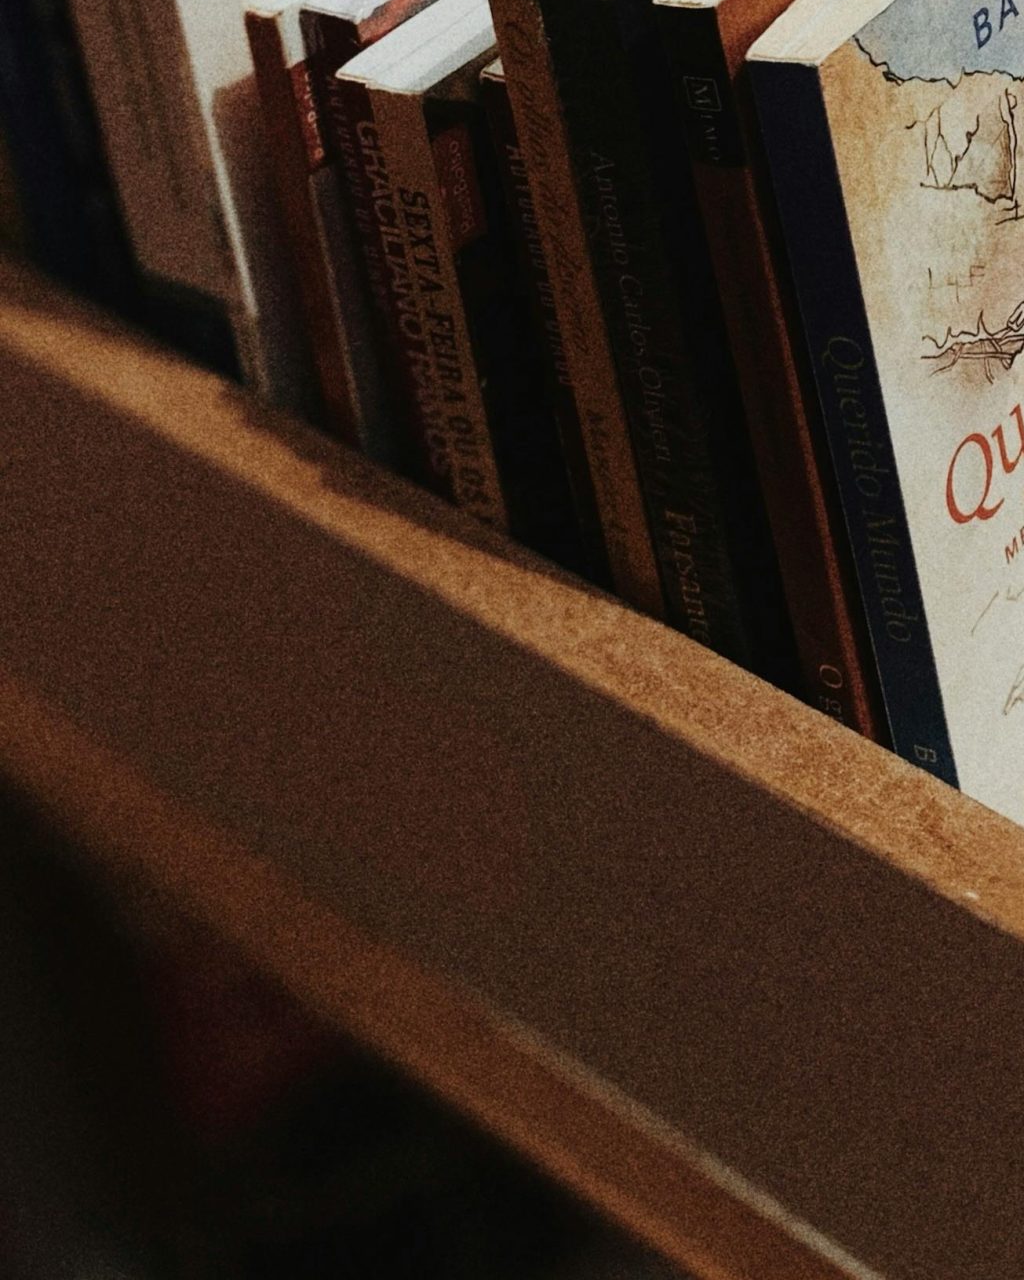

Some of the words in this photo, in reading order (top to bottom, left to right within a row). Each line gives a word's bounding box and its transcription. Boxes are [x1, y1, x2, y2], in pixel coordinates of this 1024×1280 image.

[356, 120, 425, 337] GRACILIANO
[400, 186, 467, 404] SEXTA-FEIRA
[449, 415, 479, 459] OU
[589, 150, 630, 267] Antonio
[618, 273, 653, 357] Carlos
[821, 335, 890, 498] Querido
[862, 507, 920, 644] Mundo
[819, 664, 843, 690] O
